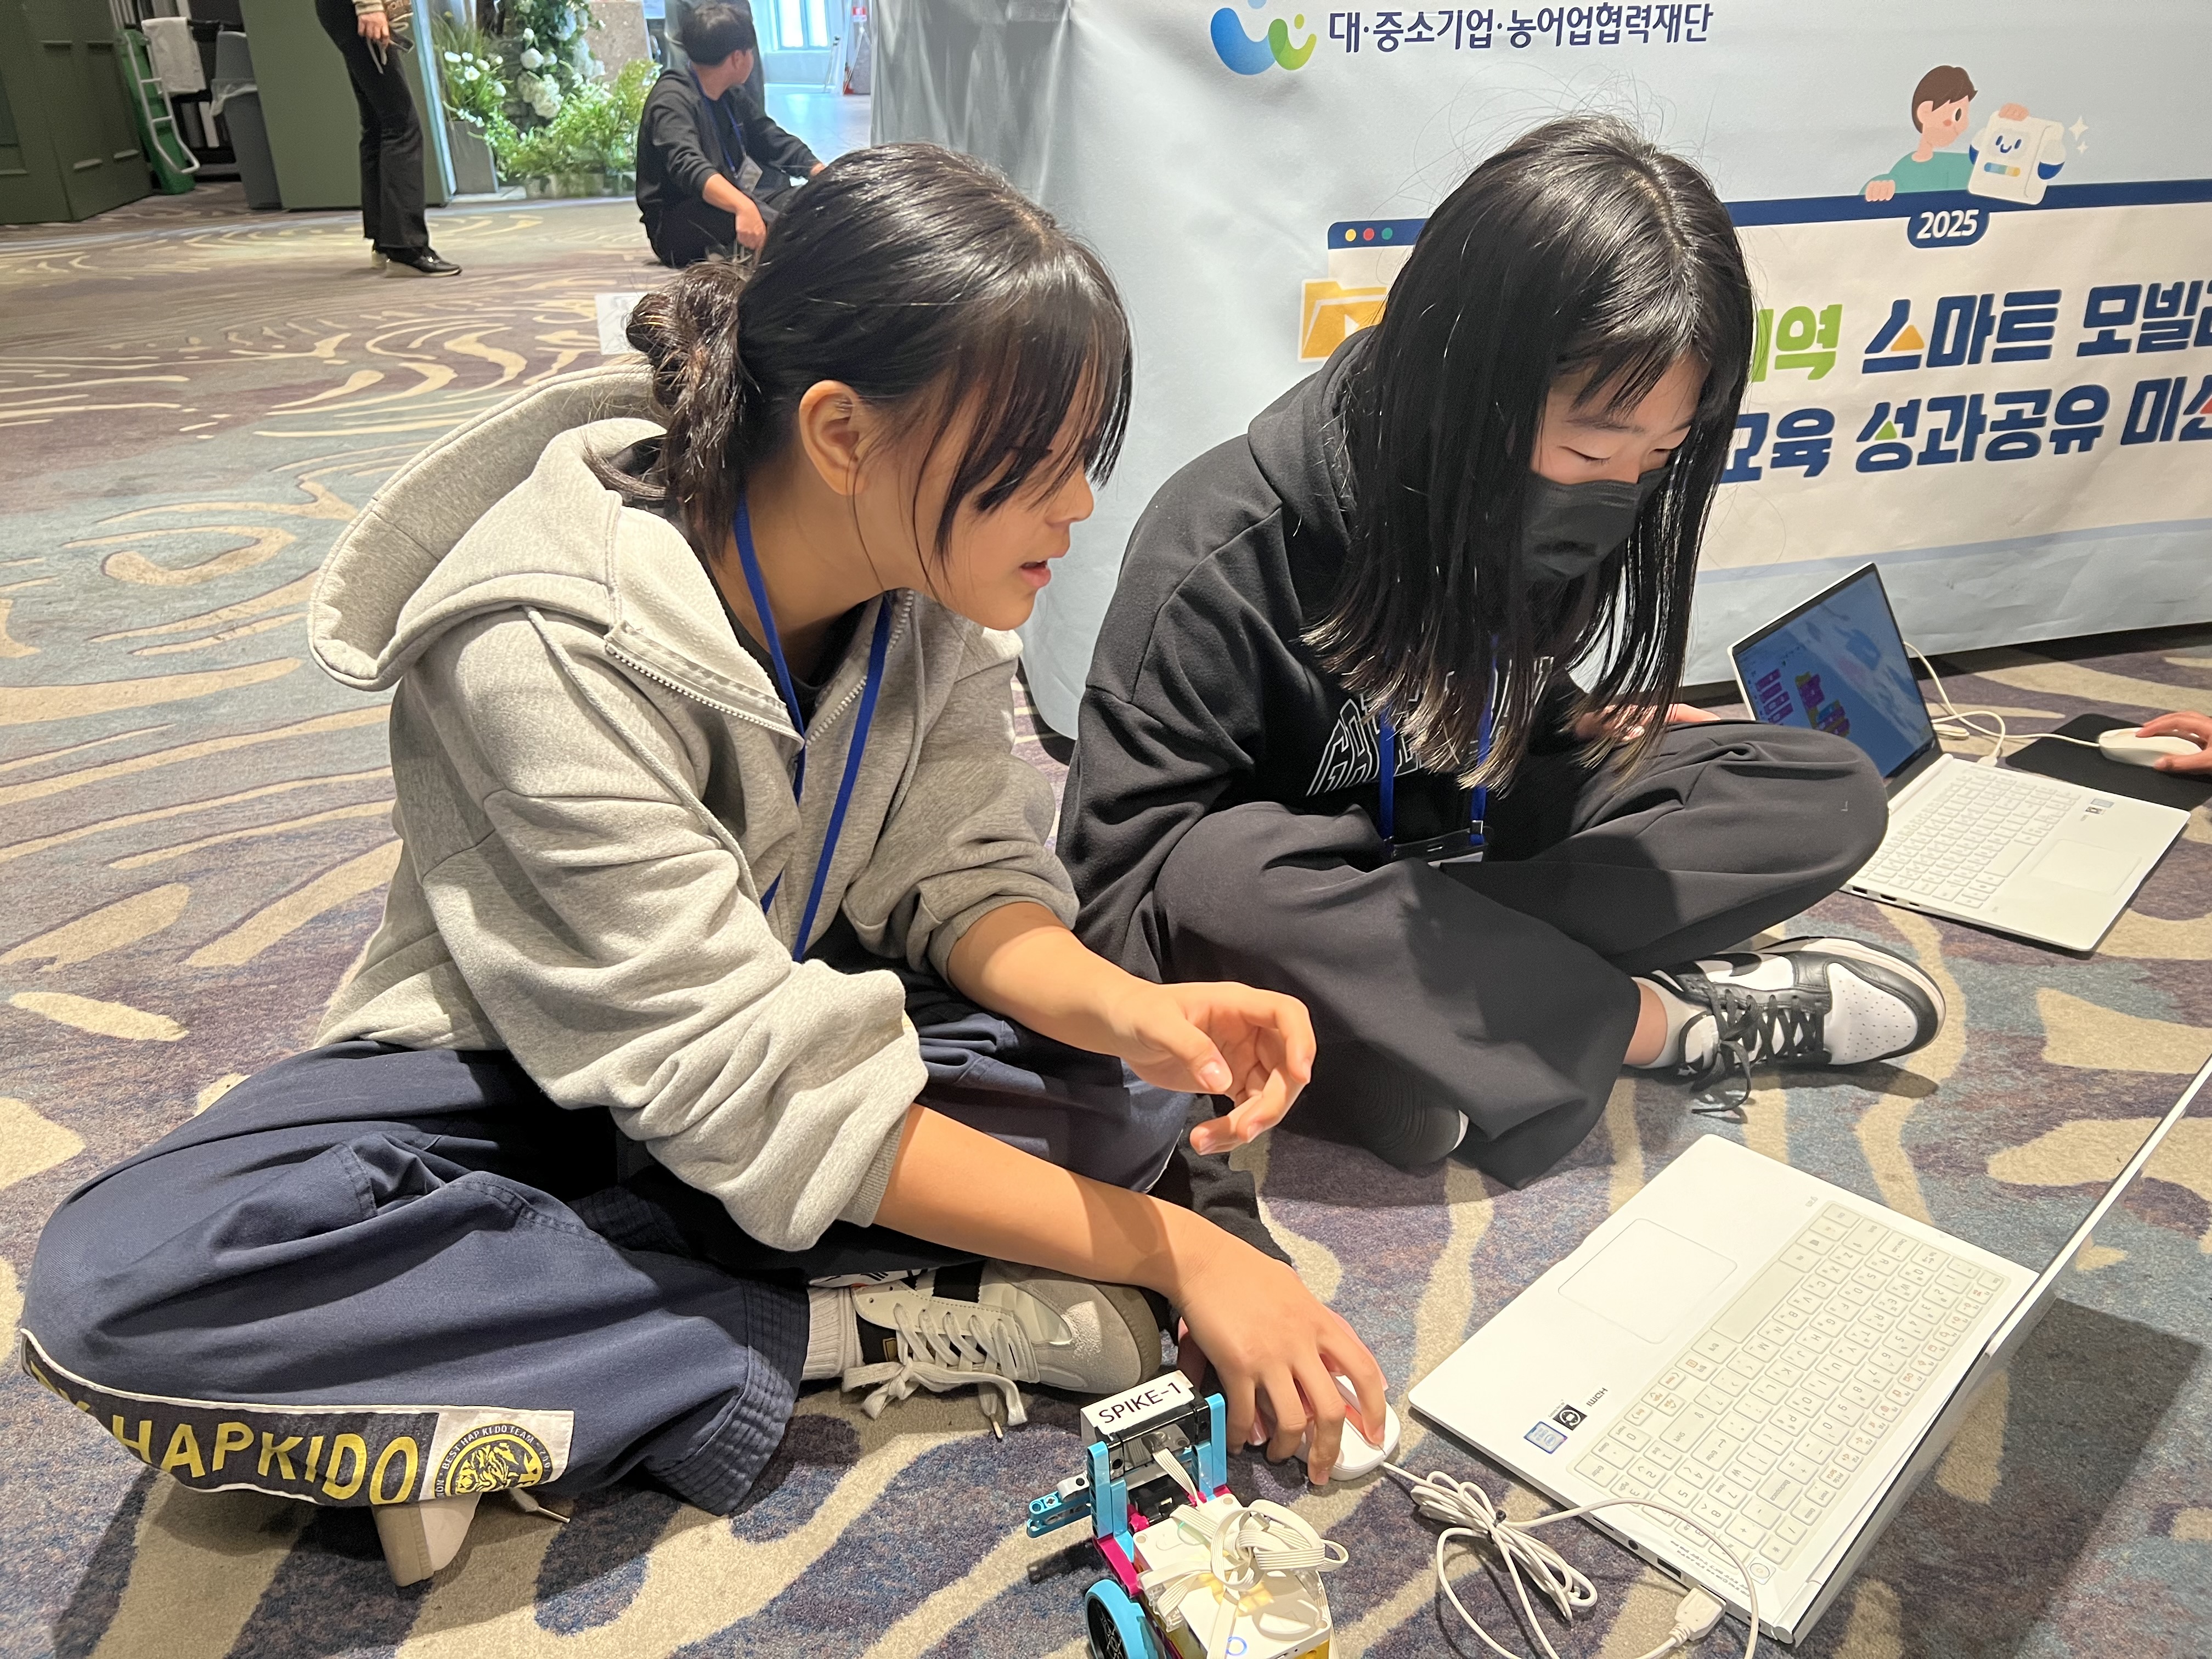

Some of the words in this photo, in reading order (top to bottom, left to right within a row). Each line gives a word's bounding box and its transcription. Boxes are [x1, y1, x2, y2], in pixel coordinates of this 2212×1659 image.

[1329, 2, 1714, 53] 대·중소기업·농어업협력재단
[1916, 209, 1980, 240] 2025
[1862, 289, 2062, 374] 스마트
[1855, 384, 2111, 473] 성과공유
[1098, 1382, 1183, 1424] SPIKE-1
[112, 1414, 419, 1505] HAPKIDO
[442, 1445, 461, 1470] BEST
[460, 1431, 480, 1446] HAP
[510, 1425, 534, 1443] TEAM
